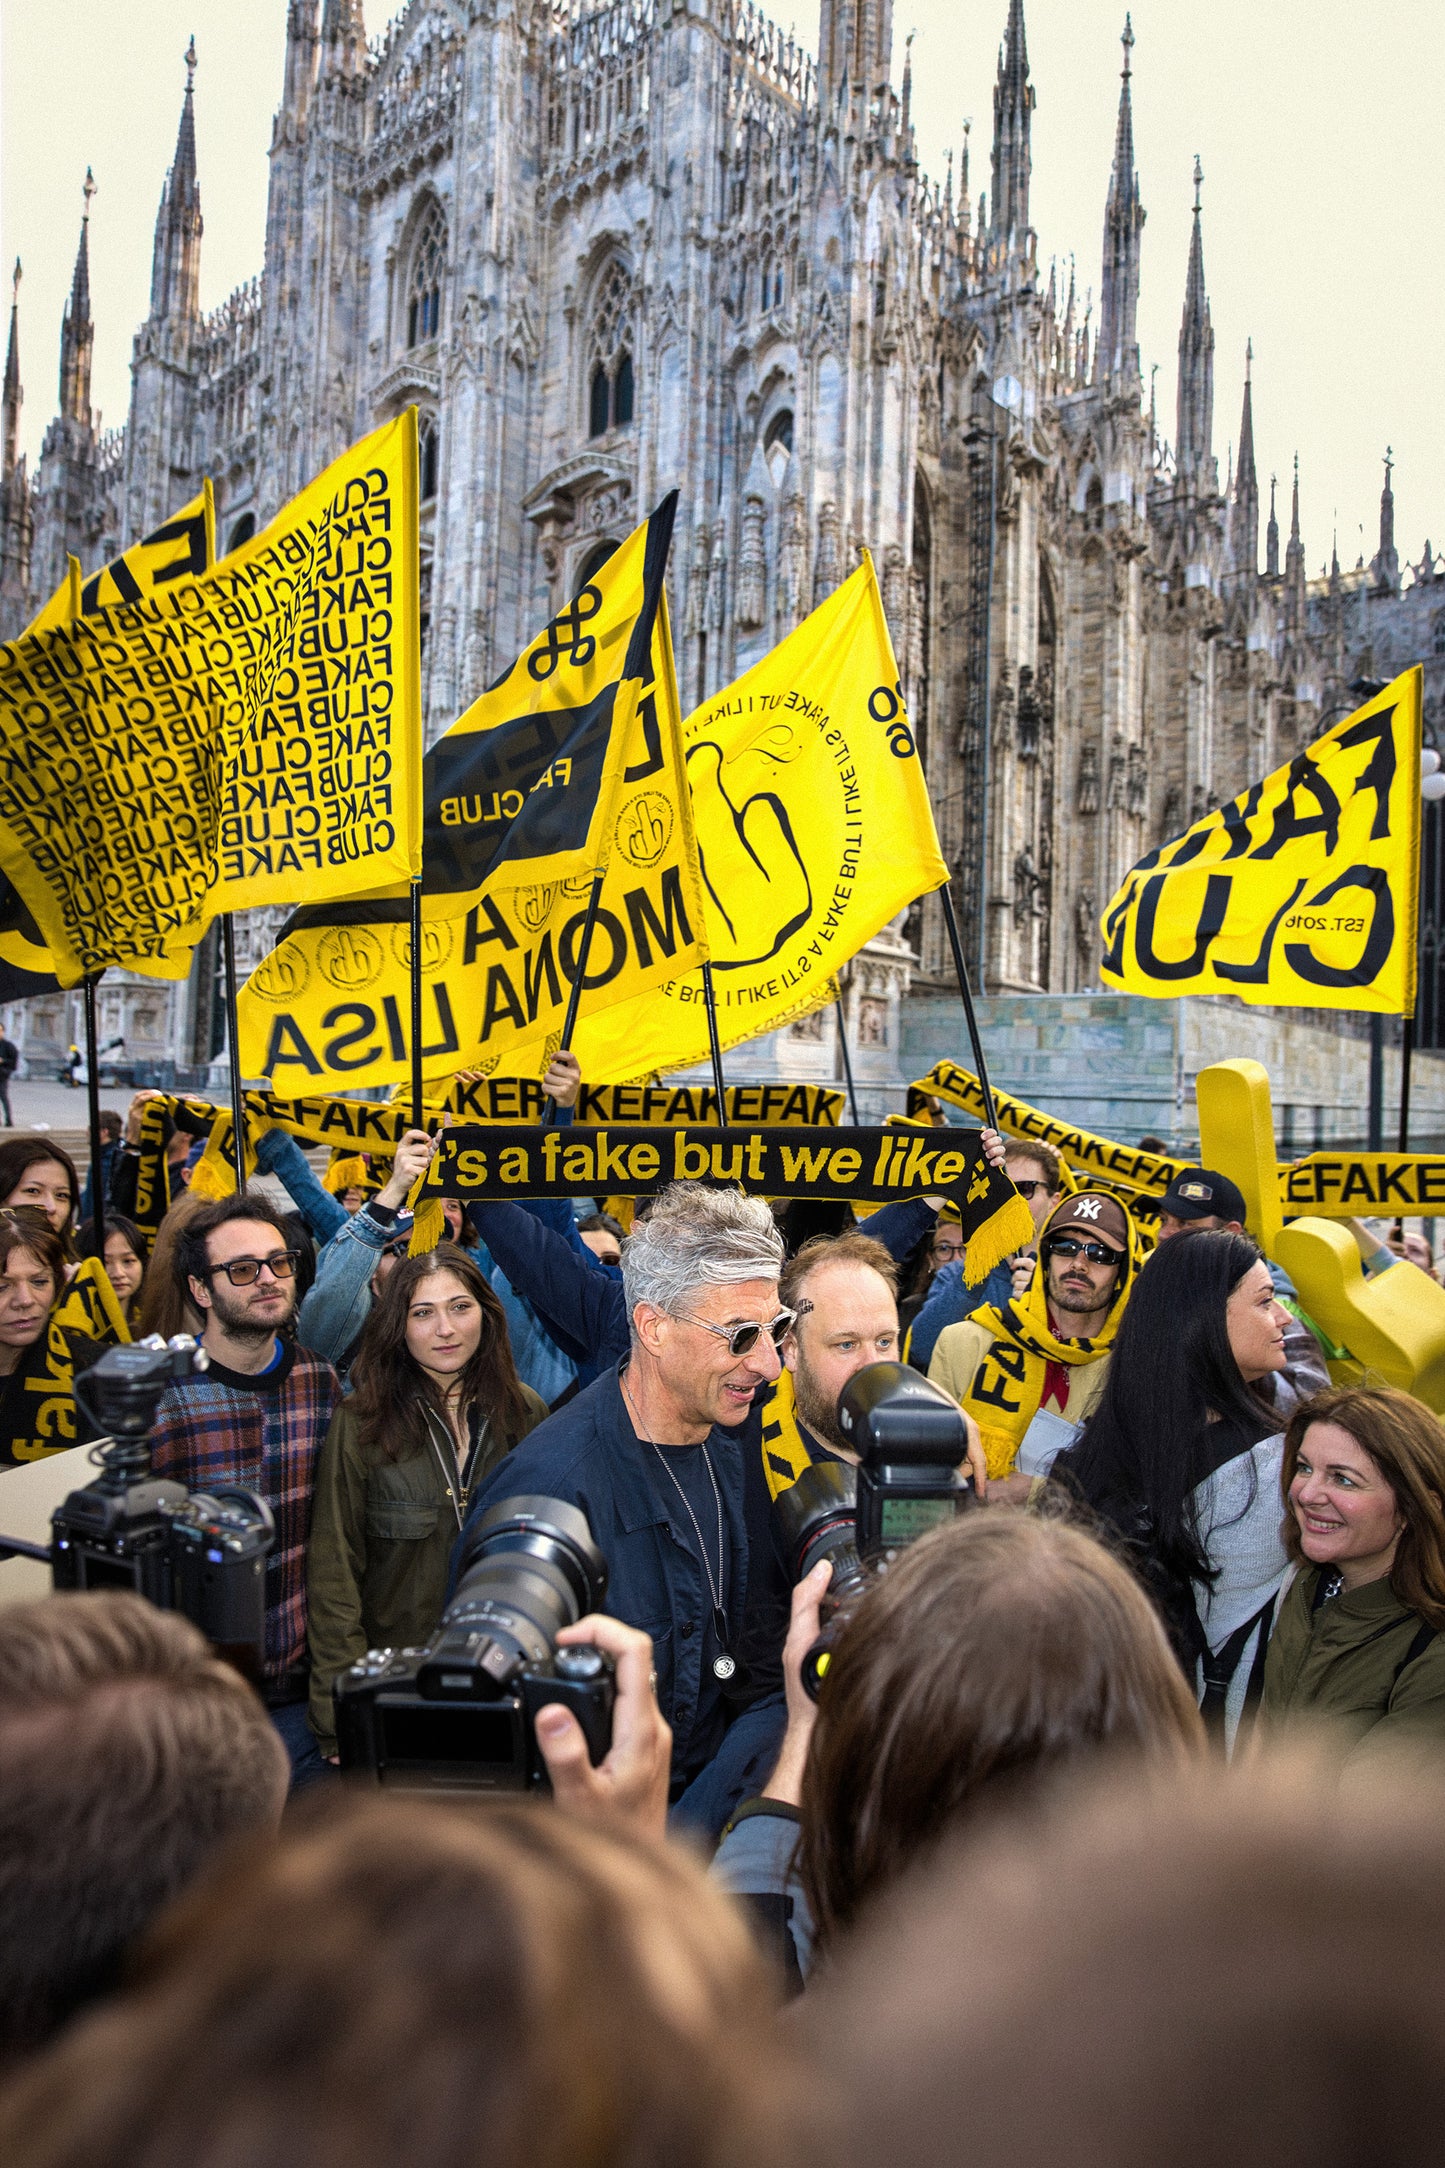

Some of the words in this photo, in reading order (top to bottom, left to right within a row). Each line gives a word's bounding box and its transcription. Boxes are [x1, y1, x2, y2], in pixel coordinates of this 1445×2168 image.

[427, 1140, 488, 1187] t's
[499, 1144, 530, 1184] a
[541, 1132, 661, 1183] fake
[674, 1131, 767, 1180] but
[780, 1146, 862, 1183] we
[873, 1135, 966, 1187] like
[971, 1341, 1027, 1413] FA
